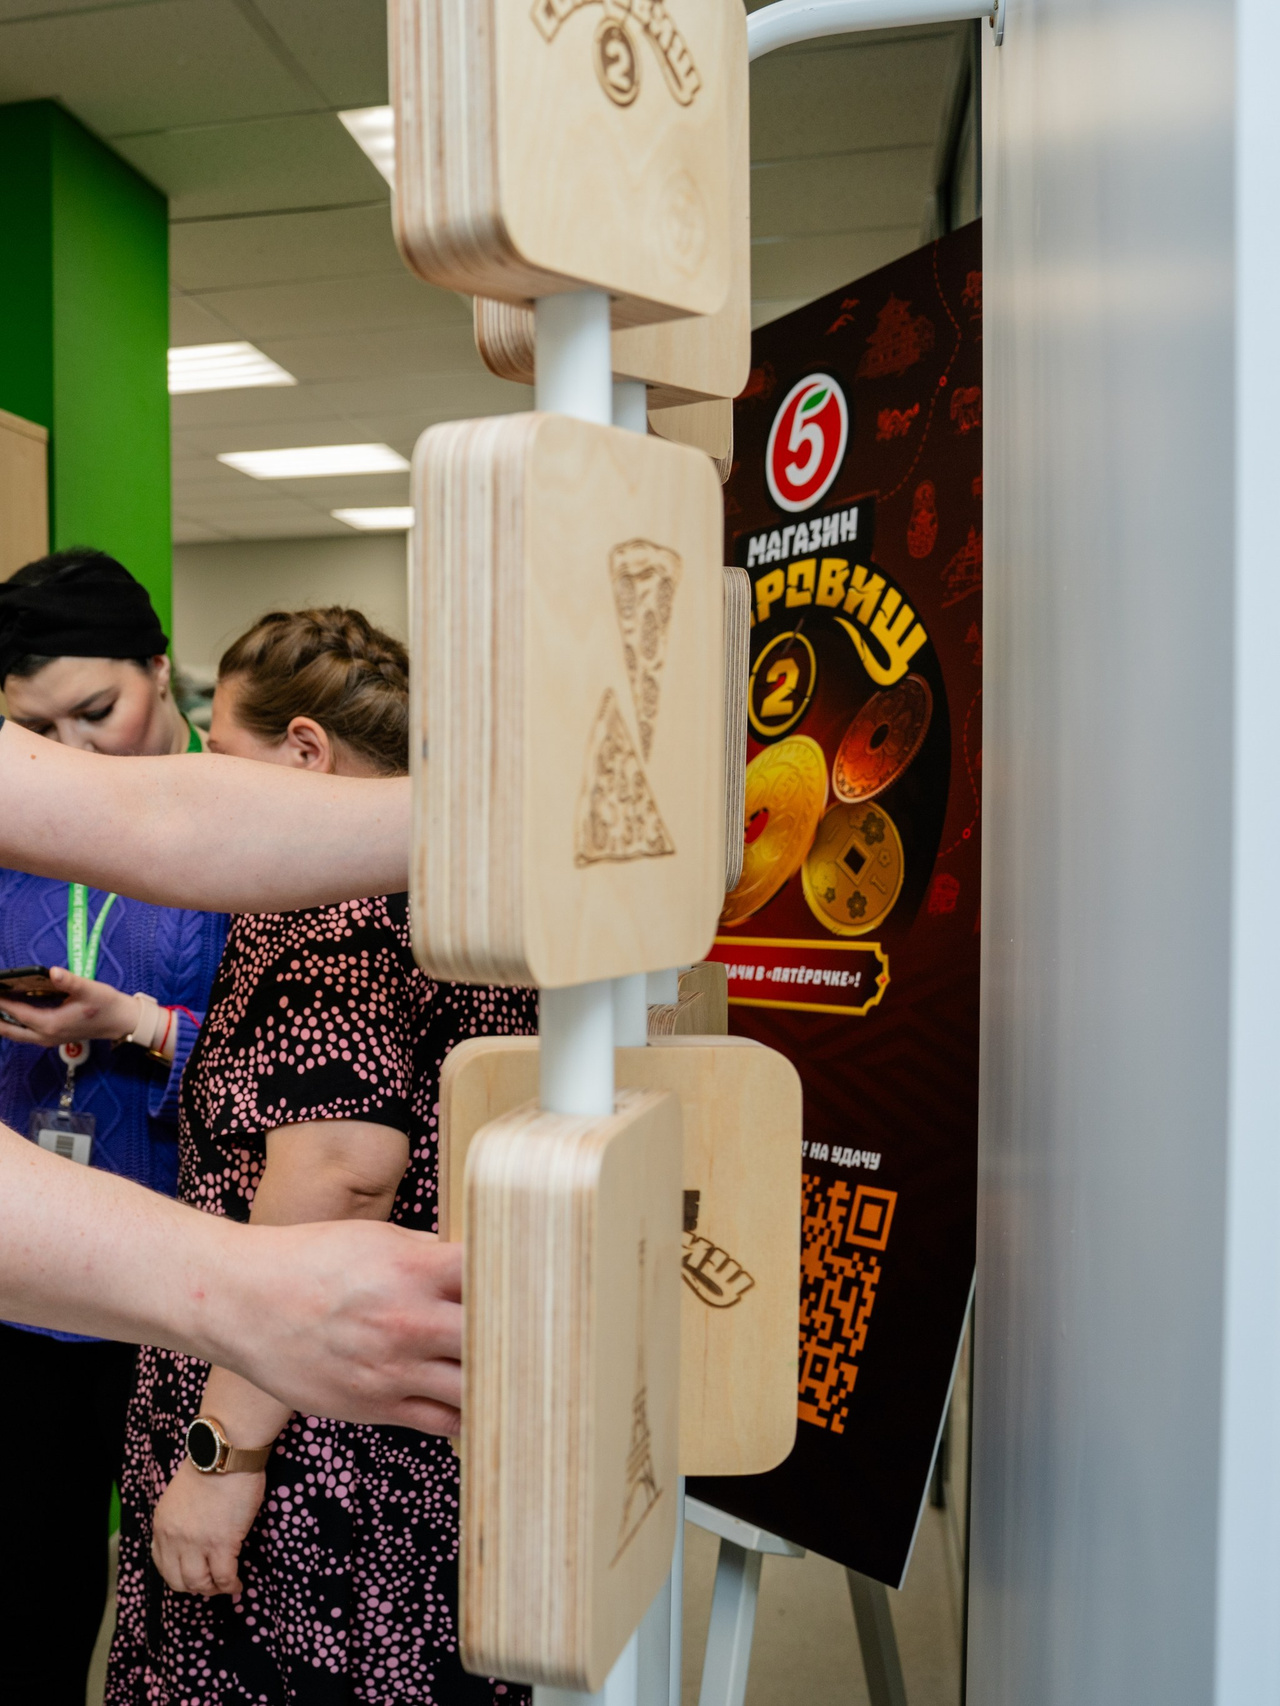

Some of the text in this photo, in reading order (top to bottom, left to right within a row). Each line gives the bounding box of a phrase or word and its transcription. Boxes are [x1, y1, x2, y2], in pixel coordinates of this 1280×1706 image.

[606, 38, 632, 91] 2
[747, 506, 858, 568] МАГАЗИН
[760, 657, 800, 718] 2
[756, 965, 765, 981] В
[766, 966, 861, 988] «ПЯТЁРОЧКЕ»!
[809, 1142, 829, 1161] НА
[831, 1145, 881, 1171] УДАЧУ
